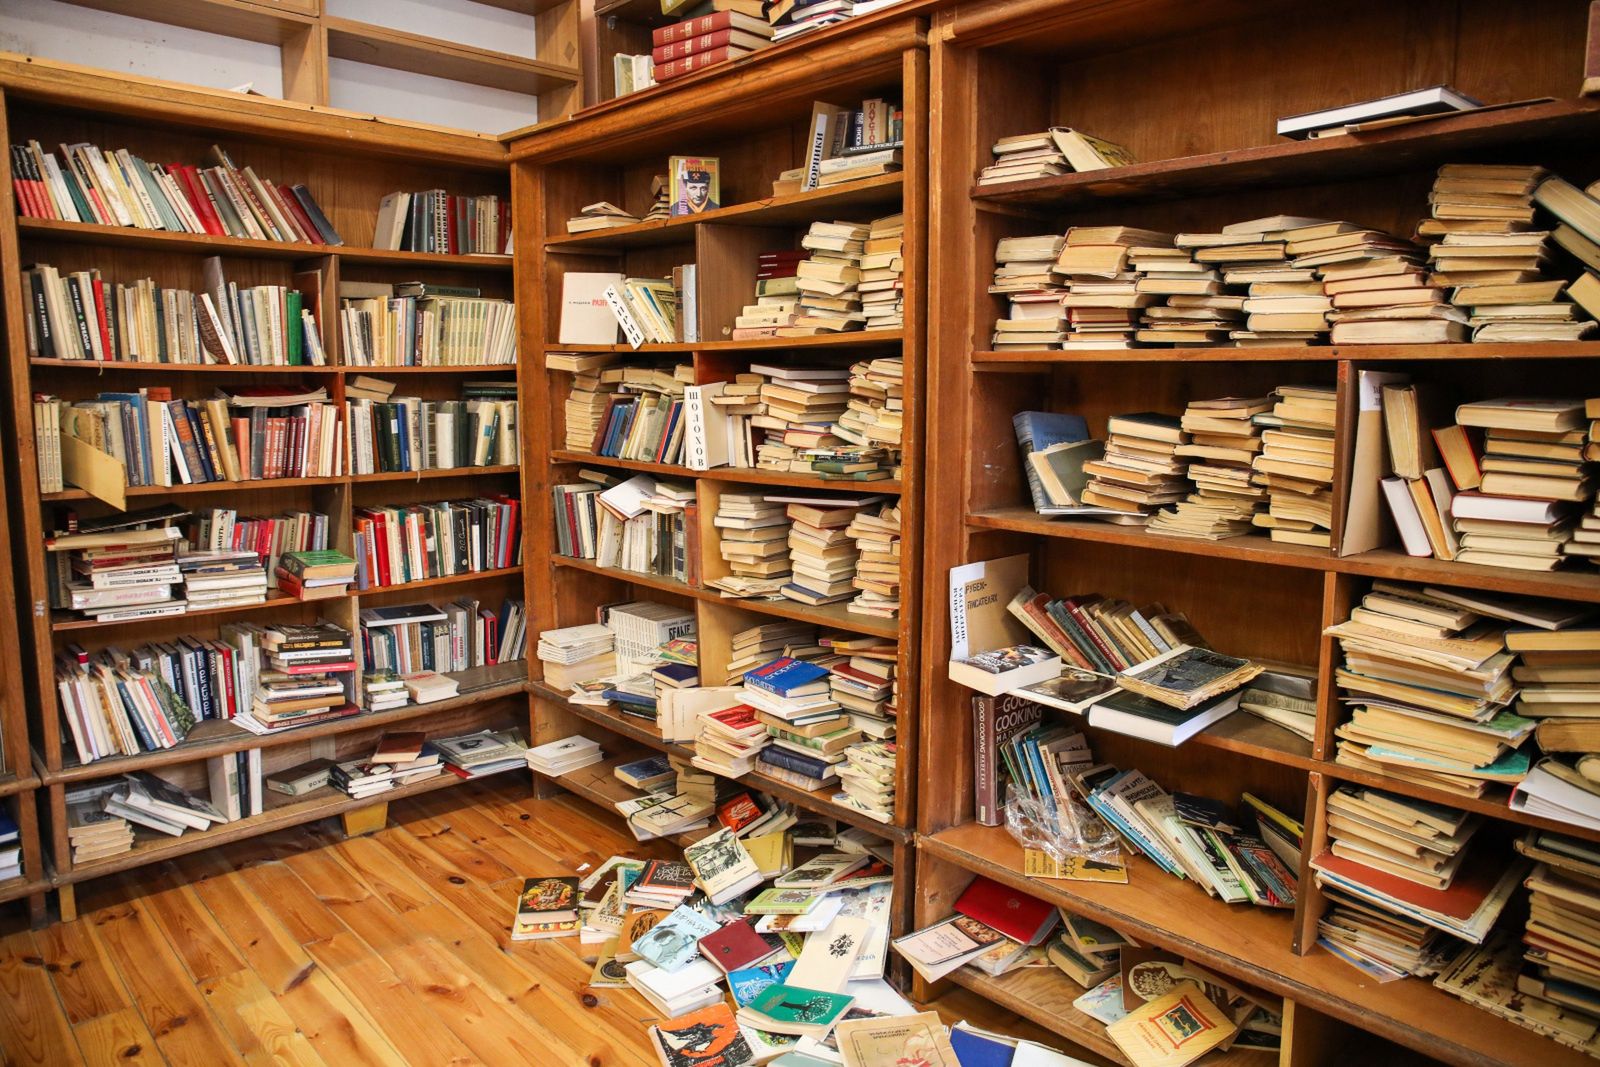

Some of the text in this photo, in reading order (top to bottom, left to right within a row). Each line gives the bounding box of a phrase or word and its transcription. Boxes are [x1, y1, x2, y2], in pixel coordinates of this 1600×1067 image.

[868, 101, 876, 145] ПАУСТО
[808, 132, 824, 189] БОРНИКИ
[688, 391, 705, 467] ШОЛОХОВ
[995, 706, 1042, 732] COOKING
